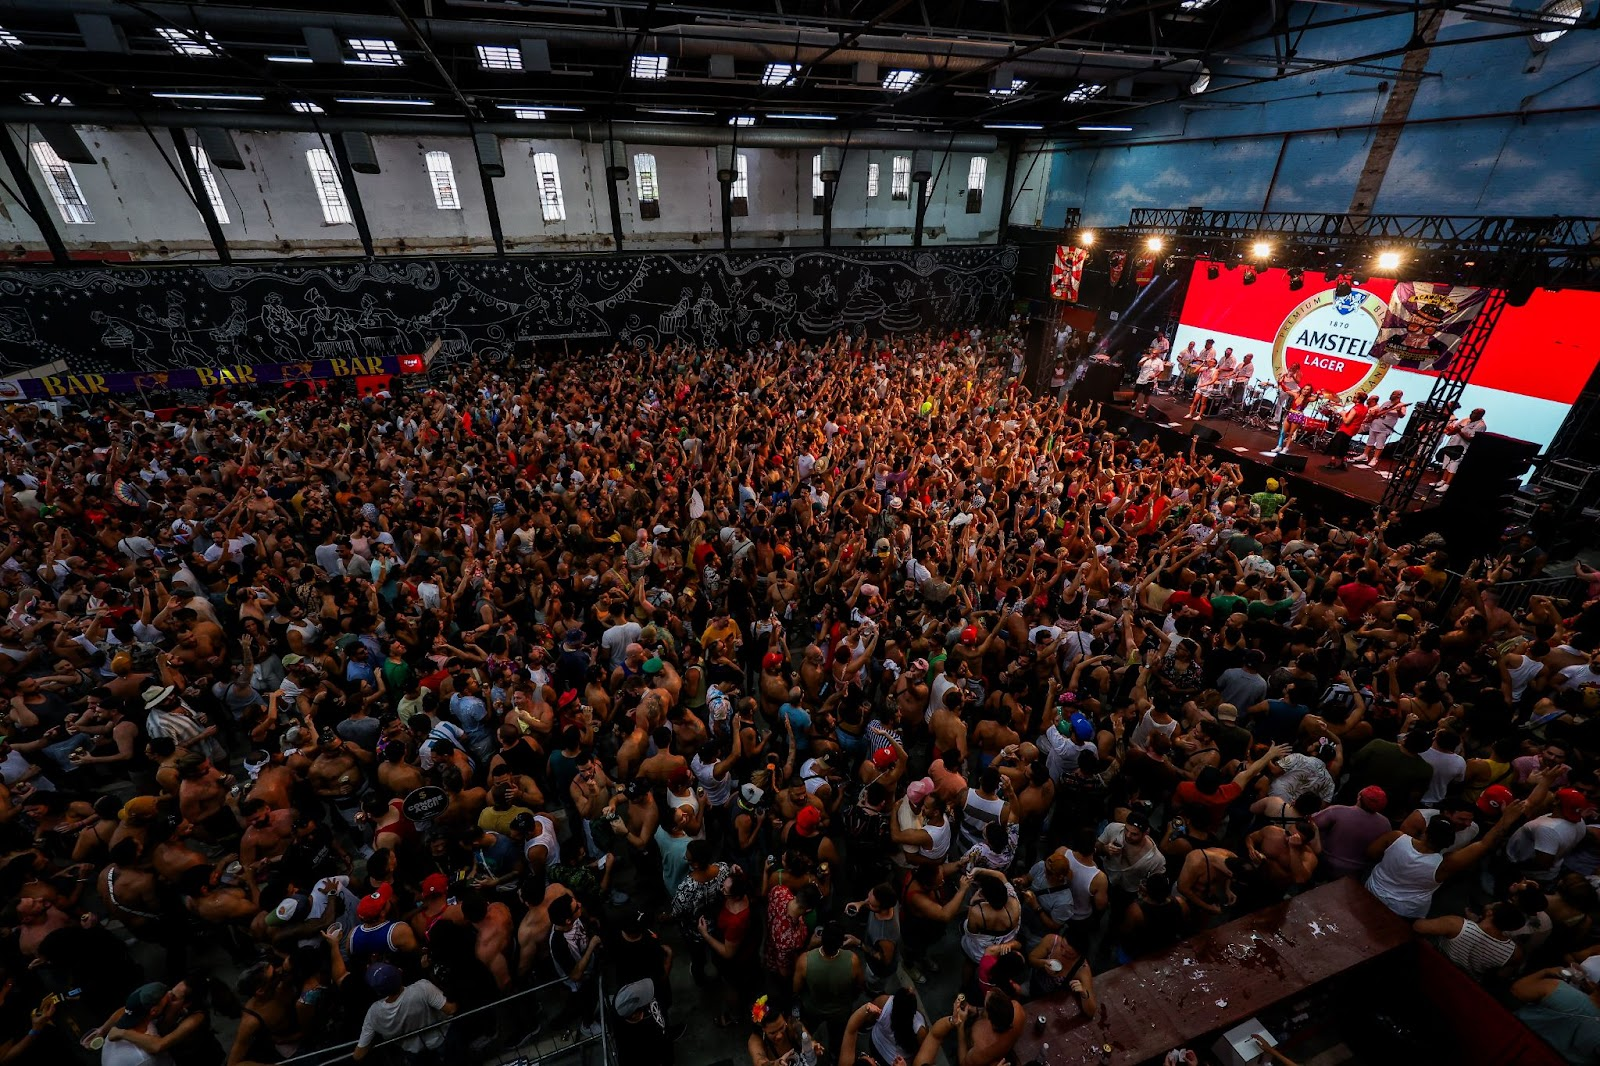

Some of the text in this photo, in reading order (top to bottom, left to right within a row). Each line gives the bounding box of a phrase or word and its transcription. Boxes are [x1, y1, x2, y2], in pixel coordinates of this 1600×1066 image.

[1279, 297, 1321, 339] PREMIUM
[1329, 320, 1349, 328] 1870
[1296, 329, 1370, 358] AMSTEL
[330, 355, 385, 377] BAR
[1303, 354, 1345, 373] LAGER
[41, 372, 109, 397] BAR
[196, 364, 257, 387] BAR
